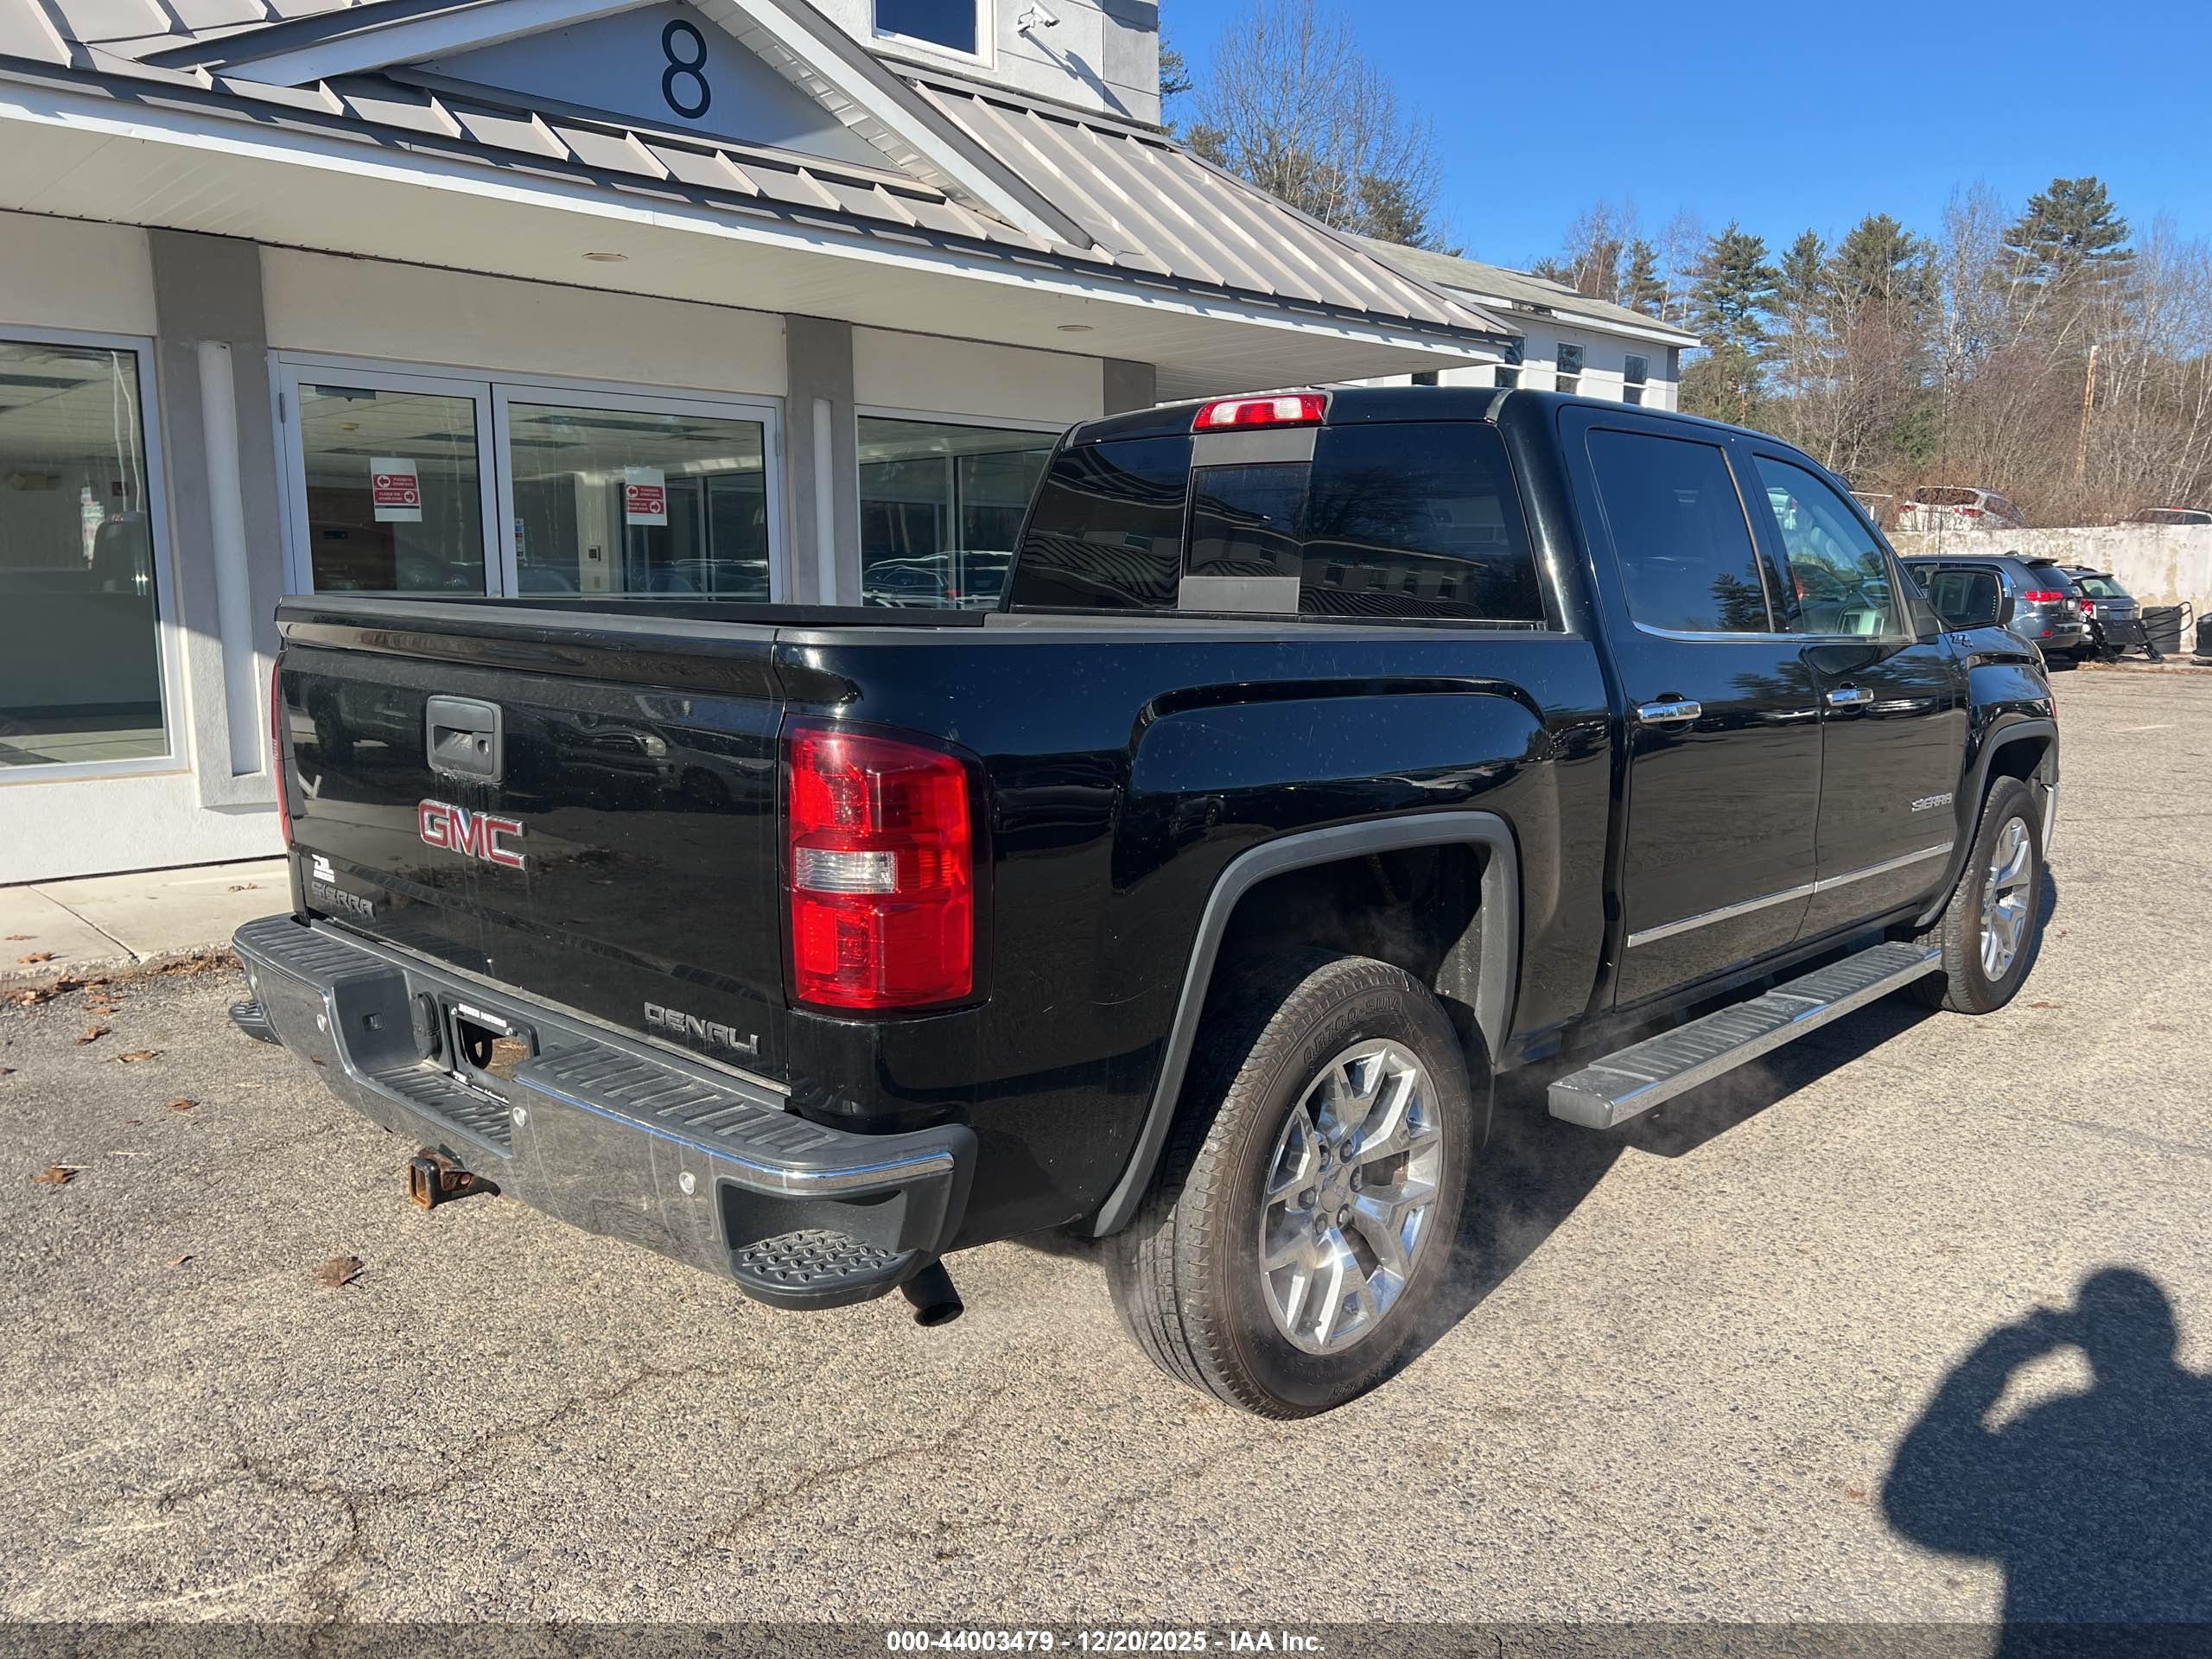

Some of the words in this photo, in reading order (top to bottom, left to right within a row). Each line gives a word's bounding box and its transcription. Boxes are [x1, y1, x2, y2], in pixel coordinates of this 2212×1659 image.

[662, 19, 711, 119] 8
[1911, 792, 1953, 812] SIERRA
[418, 798, 525, 871] GMC
[311, 881, 375, 918] SIERRA
[644, 1001, 760, 1055] DENALI
